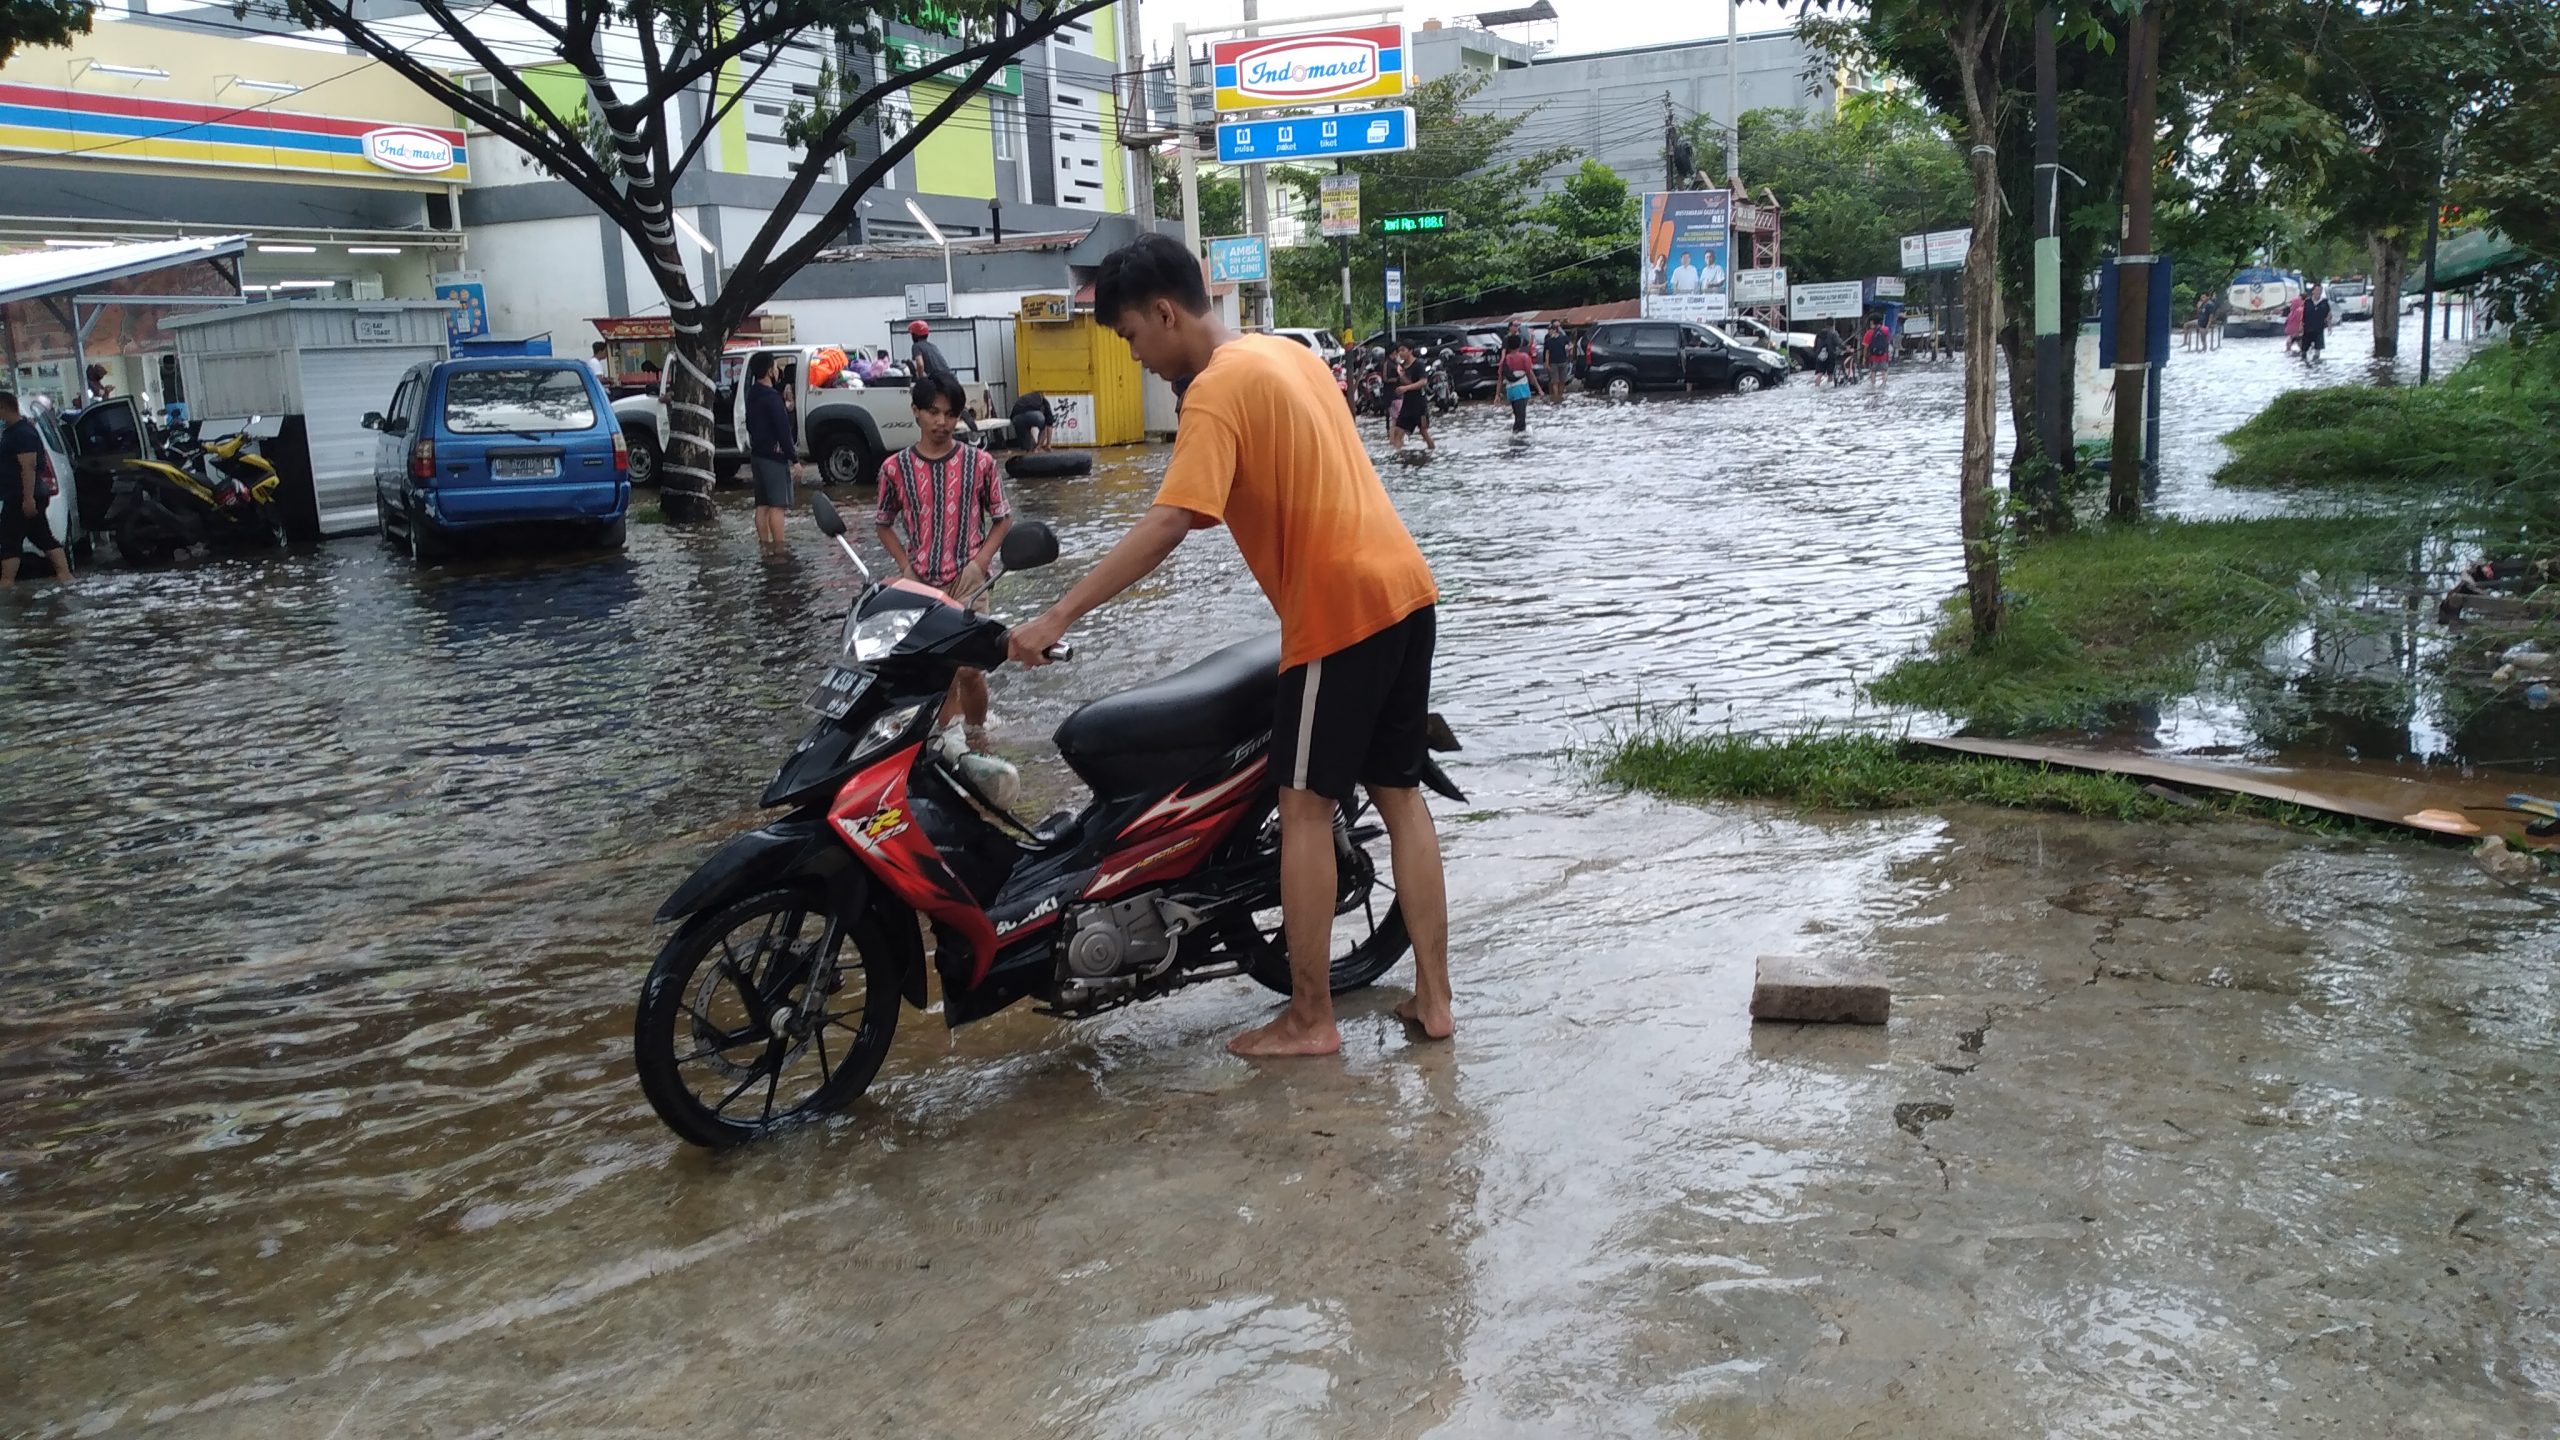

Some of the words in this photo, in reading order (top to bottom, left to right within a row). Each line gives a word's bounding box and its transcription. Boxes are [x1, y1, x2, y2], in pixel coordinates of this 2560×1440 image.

[1248, 54, 1368, 85] Indomaret
[378, 139, 447, 161] Indomaret
[1234, 145, 1255, 155] pulsa
[1276, 142, 1297, 152] paket
[1320, 138, 1338, 148] tiket
[1230, 244, 1260, 257] AMBIL
